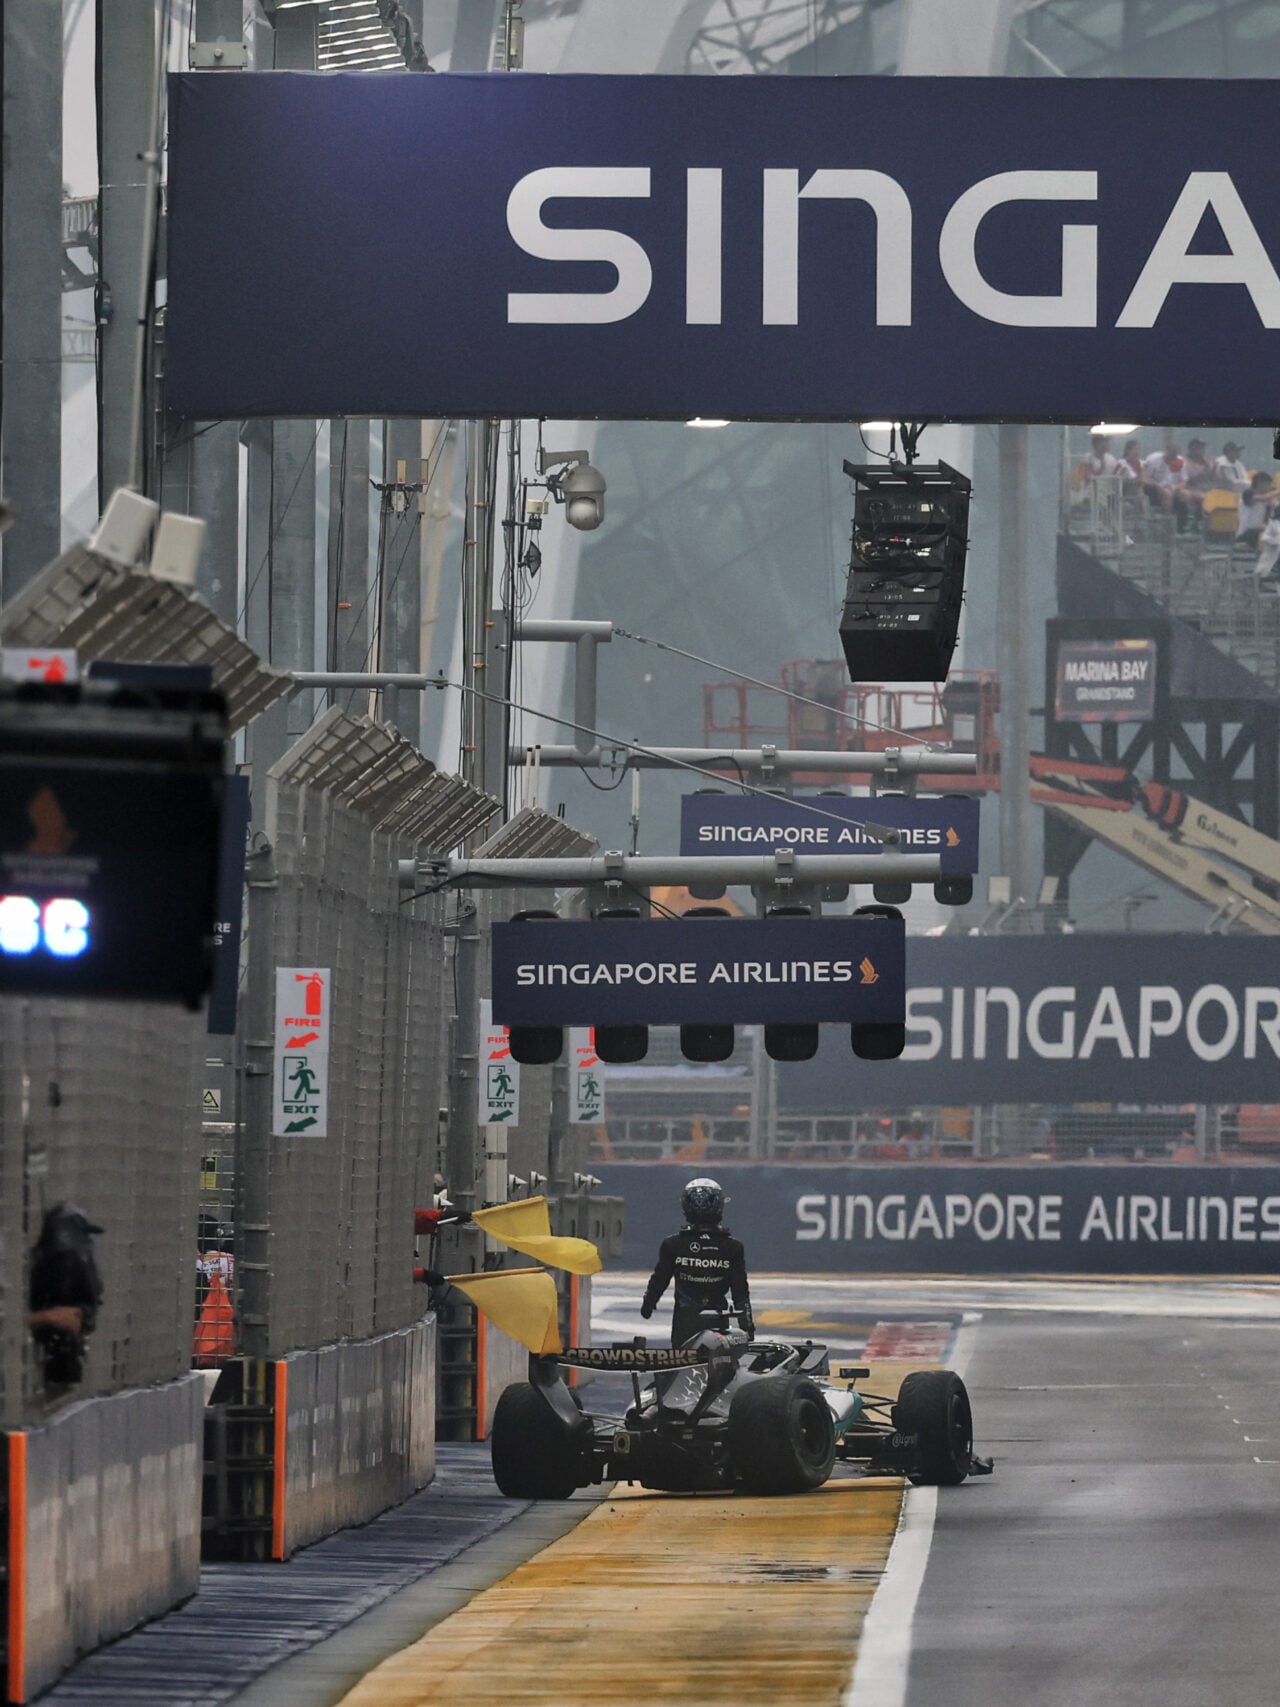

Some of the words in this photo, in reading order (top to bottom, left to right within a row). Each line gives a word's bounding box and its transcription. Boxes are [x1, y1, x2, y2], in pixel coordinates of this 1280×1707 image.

[1064, 660, 1119, 681] MARINA
[1121, 660, 1148, 681] BAY
[698, 825, 829, 844] SINGAPORE
[516, 962, 697, 985] SINGAPORE
[708, 960, 852, 984] AIRLINES
[284, 1017, 321, 1027] FIRE
[487, 1036, 510, 1044] FIR
[283, 1105, 320, 1114] EXIT
[795, 1193, 1062, 1241] SINGAPORE
[675, 1256, 730, 1269] PETRONAS
[566, 1350, 699, 1365] CROWDSTRIKE
